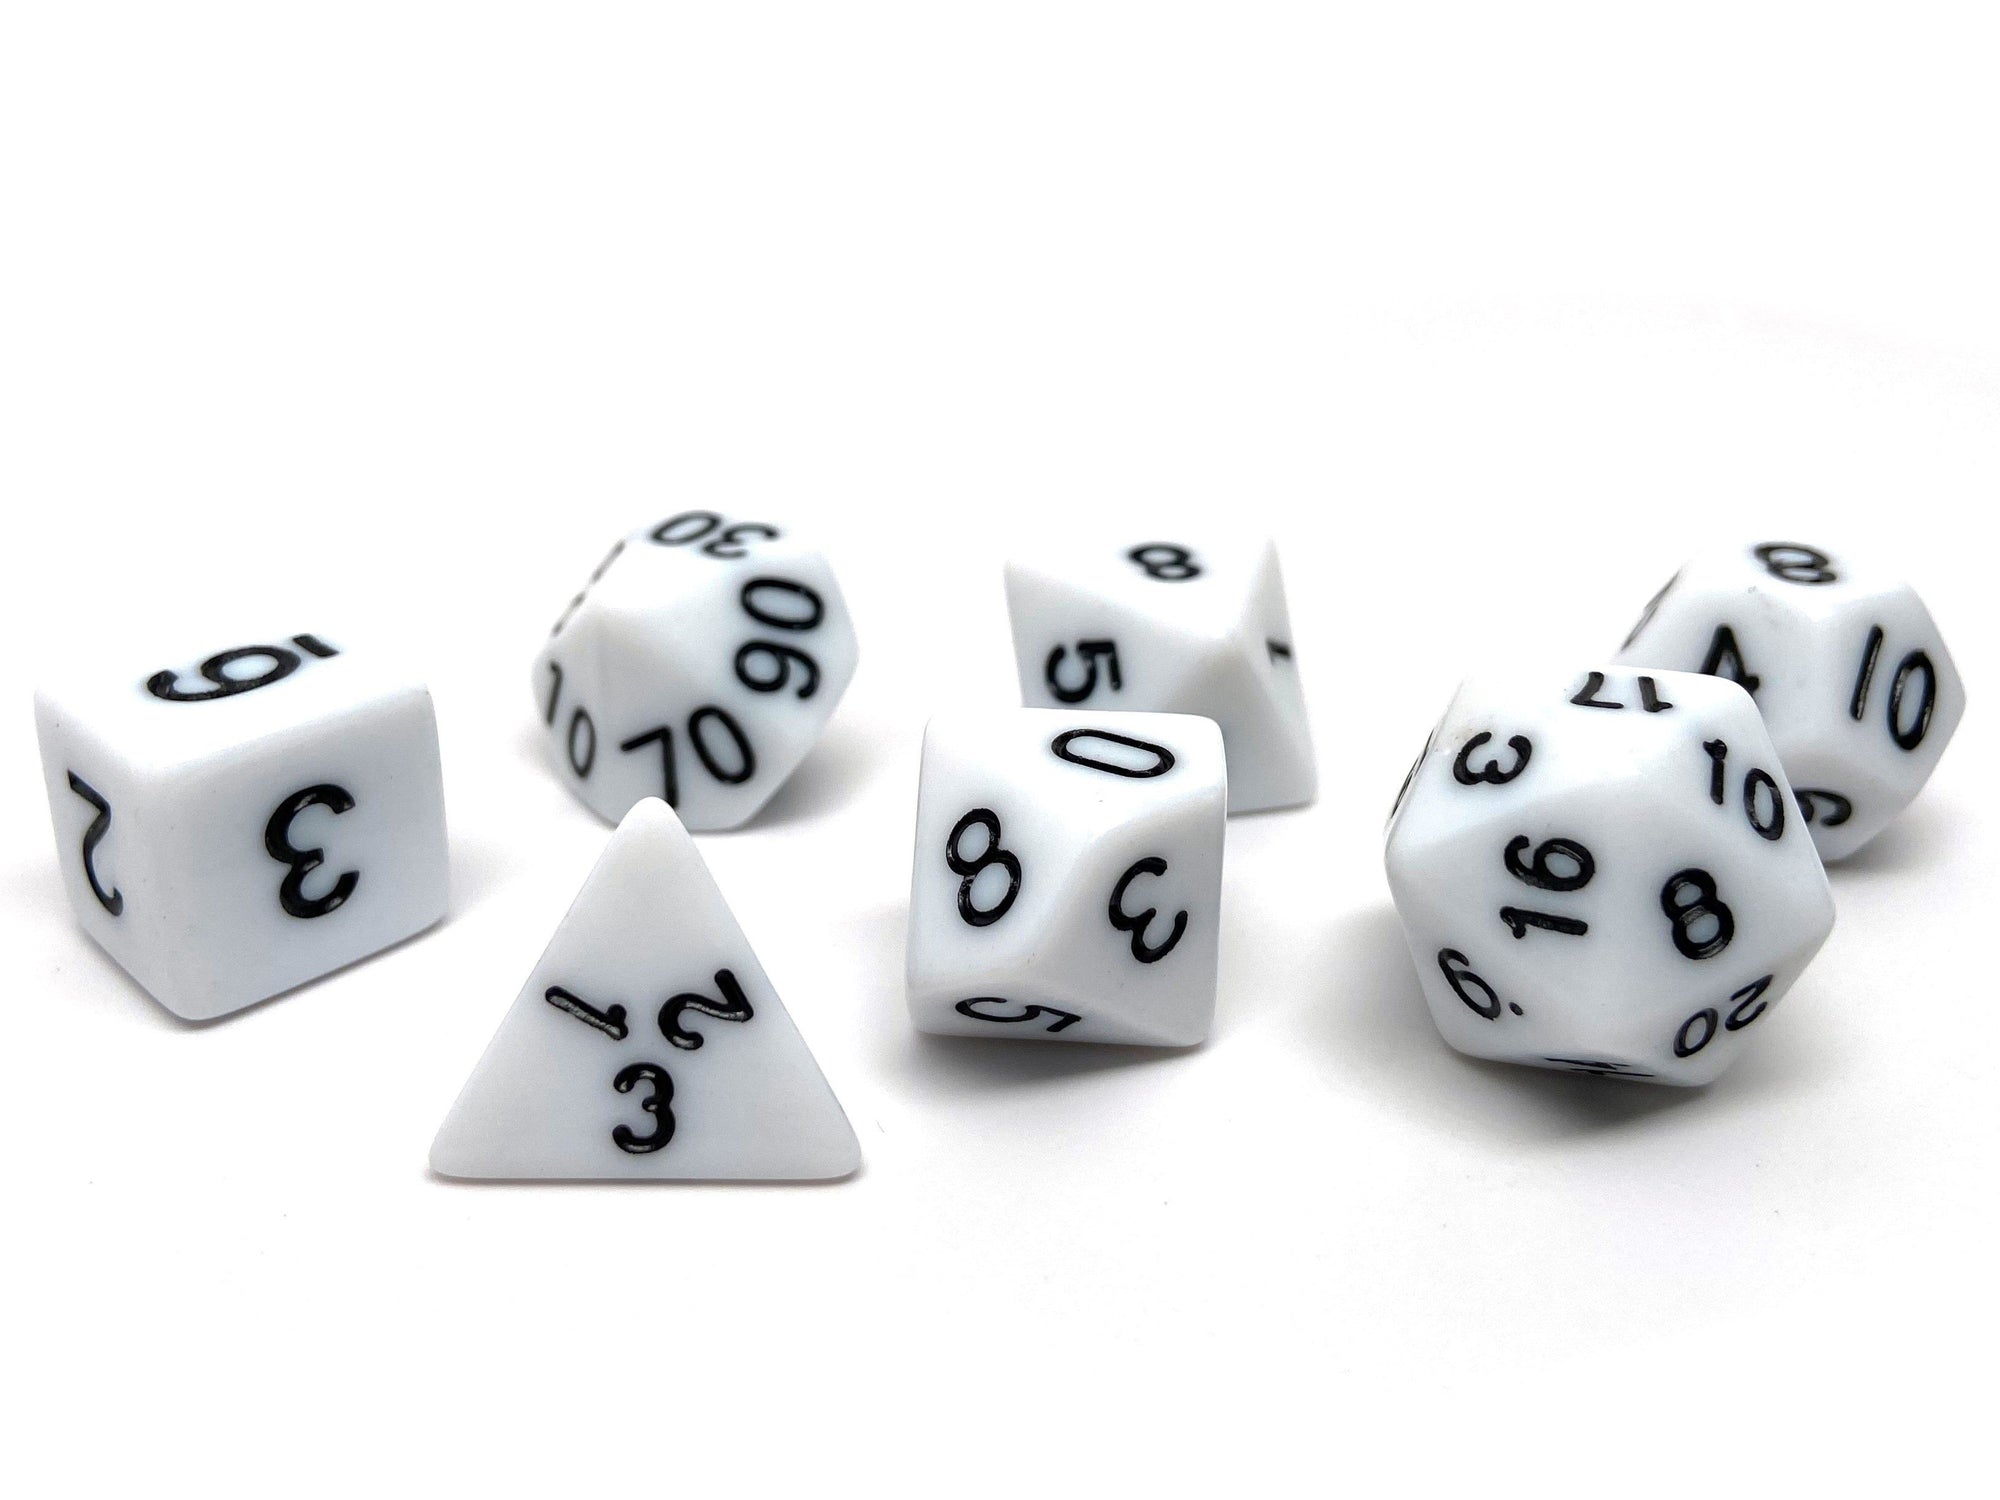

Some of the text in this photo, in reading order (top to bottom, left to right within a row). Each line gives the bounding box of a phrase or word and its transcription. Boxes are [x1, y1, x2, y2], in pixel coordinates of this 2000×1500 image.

[1127, 544, 1201, 581] 8
[1755, 544, 1838, 584] 8
[1044, 638, 1124, 706] 5
[1570, 671, 1674, 713] 17
[1849, 624, 1938, 753] 10
[546, 661, 597, 780] 10
[620, 704, 757, 812] 70
[1050, 728, 1176, 779] 0
[1453, 731, 1532, 786] 3
[1702, 738, 1786, 842] 10
[263, 783, 360, 919] 3
[945, 807, 1023, 928] 8
[1498, 834, 1597, 940] 16
[1107, 855, 1189, 965] 3
[1658, 867, 1736, 962] 8
[545, 985, 630, 1042] 1
[657, 968, 755, 1052] 2
[954, 996, 1083, 1034] 5
[1672, 973, 1775, 1059] 20
[611, 1061, 677, 1157] 3
